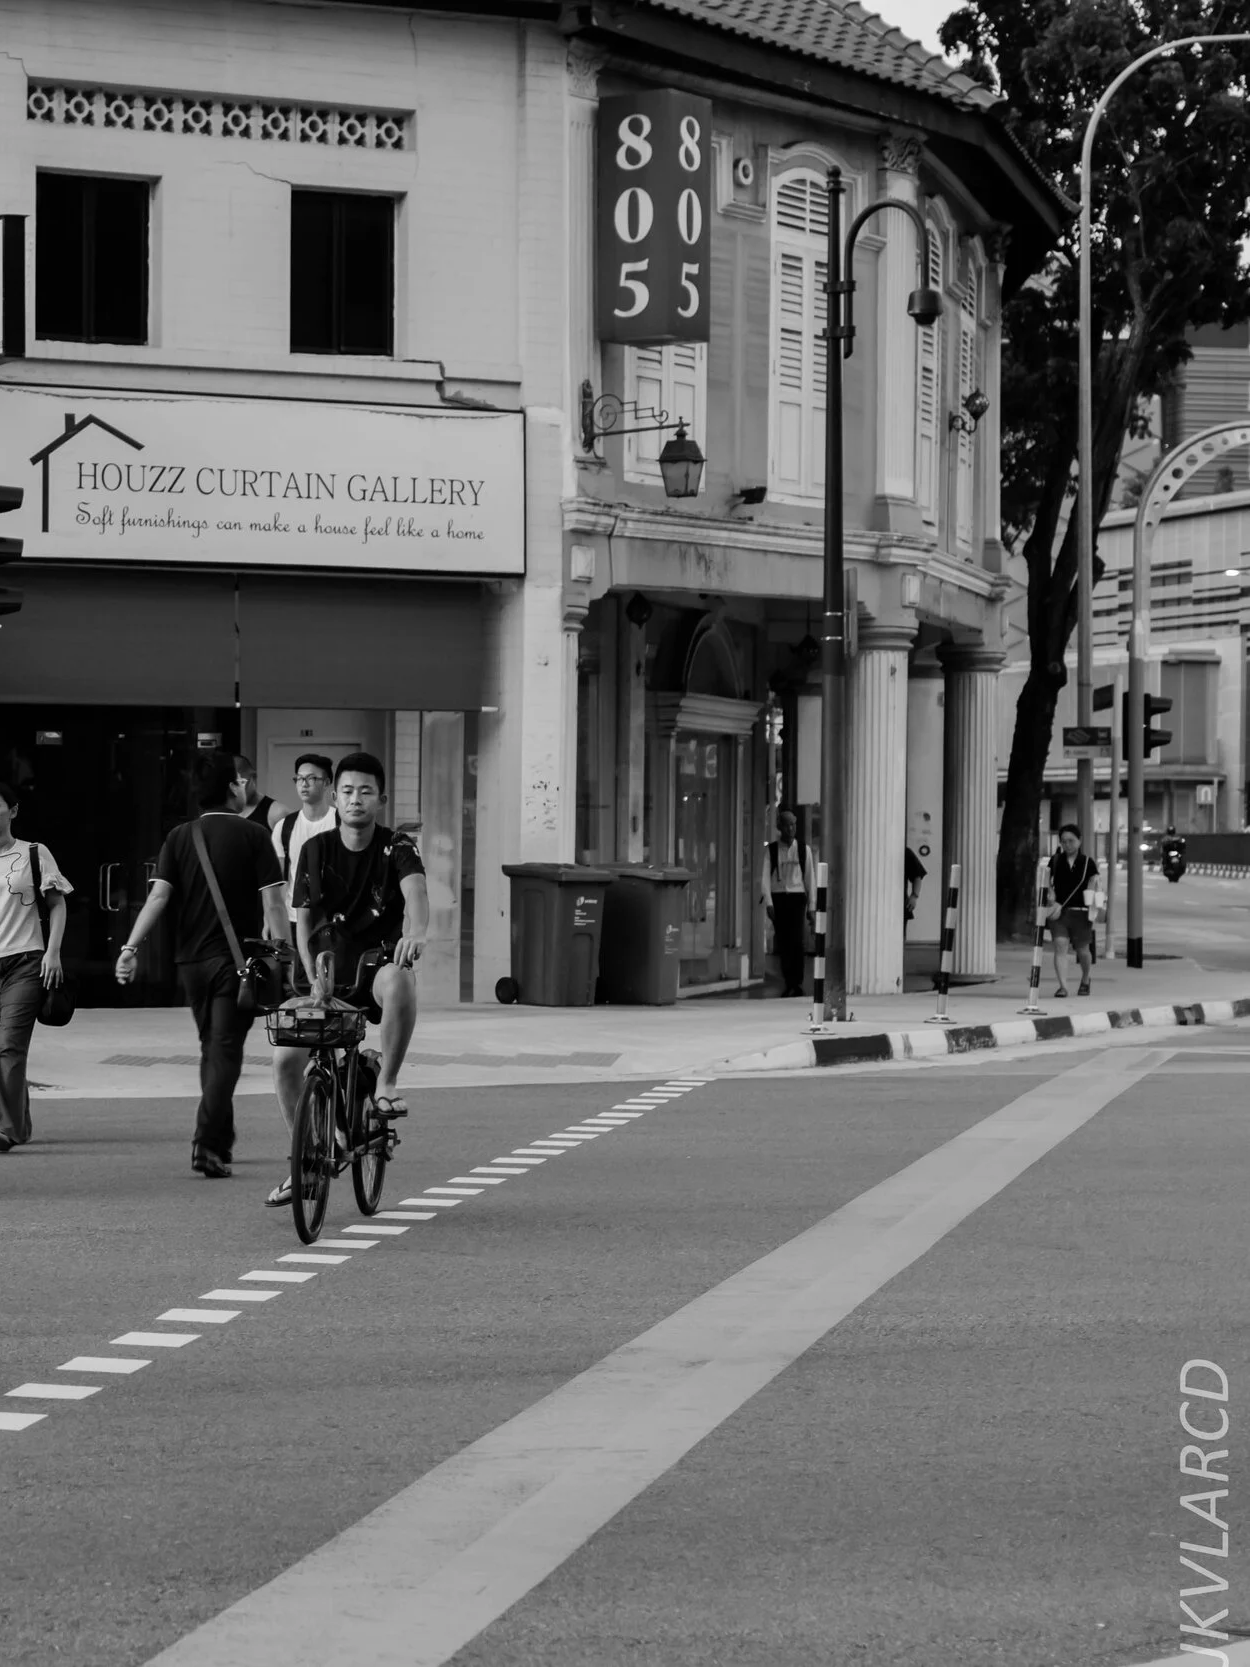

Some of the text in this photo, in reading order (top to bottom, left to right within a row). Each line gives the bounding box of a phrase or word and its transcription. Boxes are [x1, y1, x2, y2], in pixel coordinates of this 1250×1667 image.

[76, 462, 485, 506] HOUZZ CURTAIN GALLERY
[75, 501, 485, 545] Soft furnishings can make a house feel like a home
